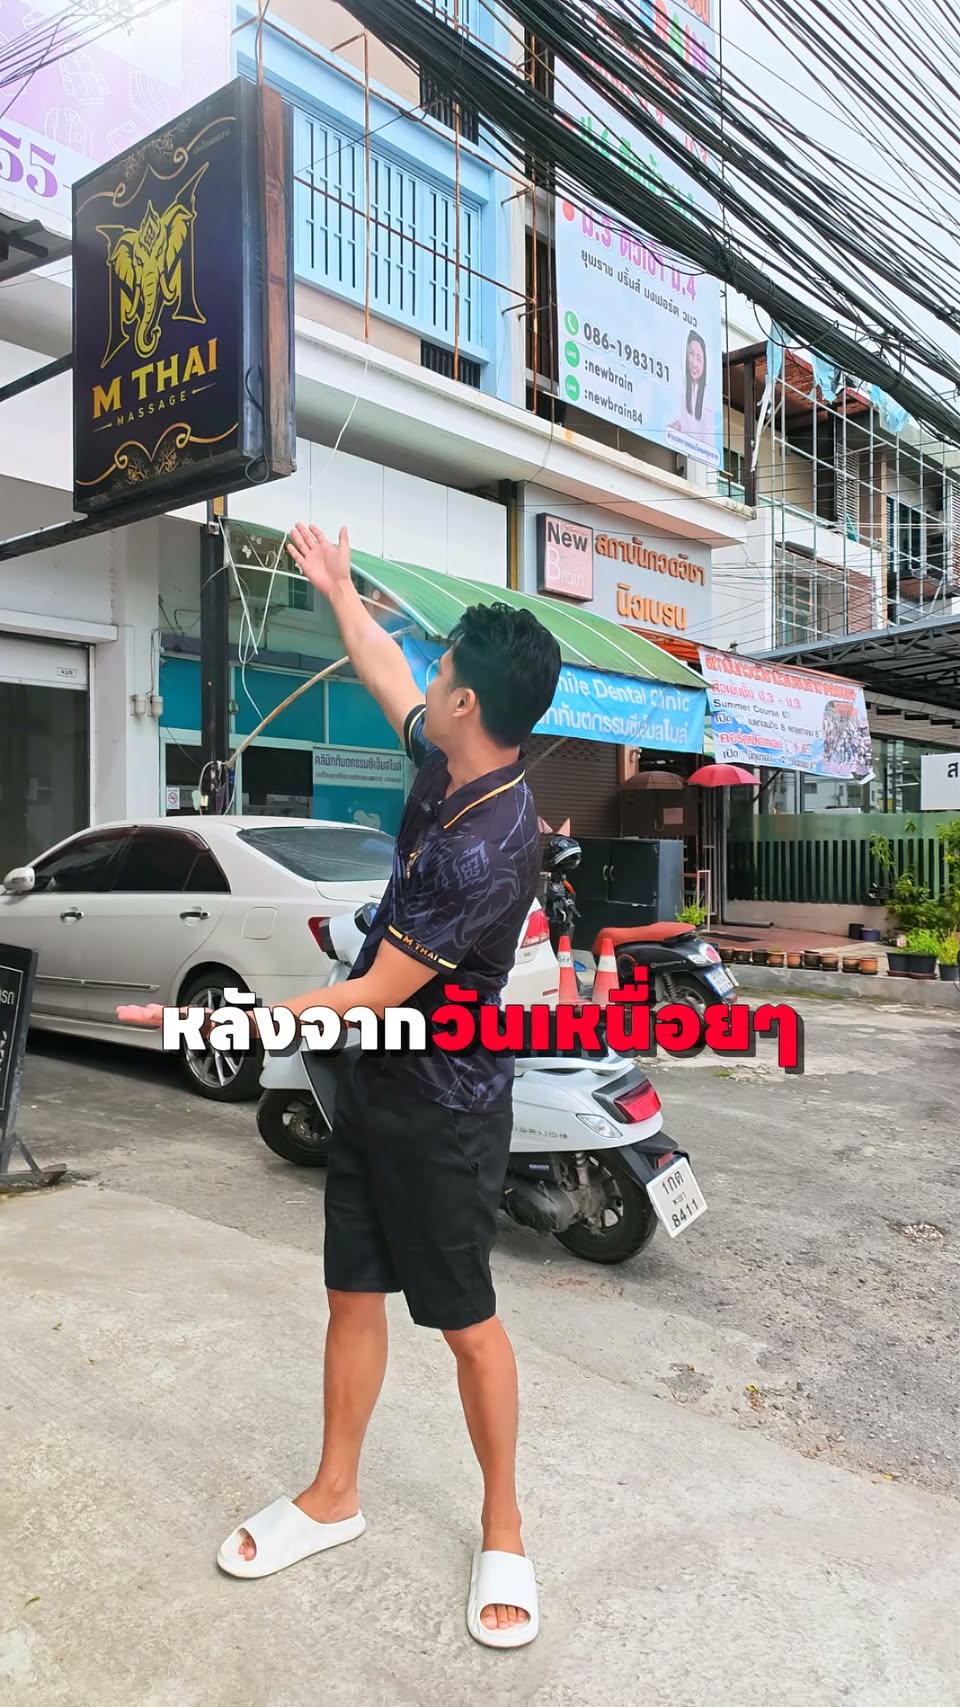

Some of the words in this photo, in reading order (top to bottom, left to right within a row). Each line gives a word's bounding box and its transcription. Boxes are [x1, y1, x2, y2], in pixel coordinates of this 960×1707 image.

[584, 322, 670, 383] 086-1983131
[92, 376, 122, 419] M
[131, 337, 218, 400] THAI
[117, 390, 187, 426] MASSAGE
[547, 521, 588, 552] New
[595, 533, 705, 586] สถาบันกวดวิชา
[616, 582, 687, 631] นิวเบรน
[593, 678, 646, 705] Dental
[403, 935, 413, 946] M
[415, 942, 438, 961] THAI
[671, 1198, 699, 1228] 8411
